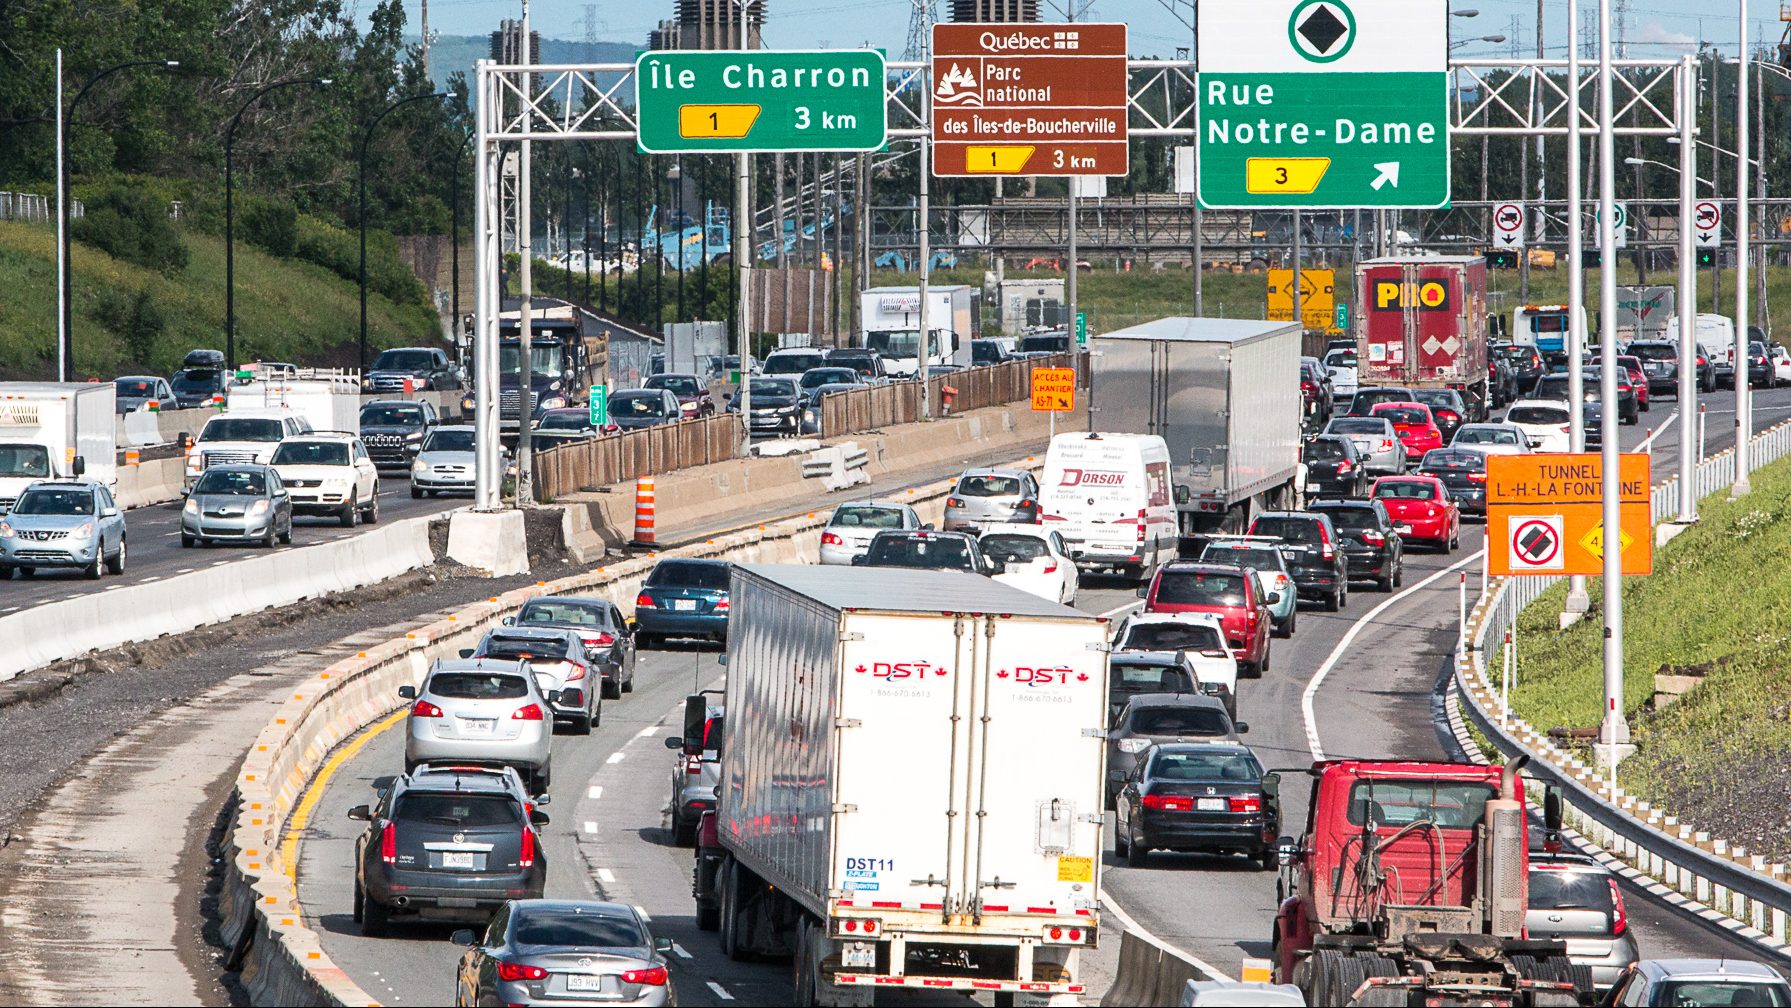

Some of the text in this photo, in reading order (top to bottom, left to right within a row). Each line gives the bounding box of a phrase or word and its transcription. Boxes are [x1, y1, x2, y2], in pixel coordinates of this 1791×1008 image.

[979, 31, 1051, 52] Québec
[649, 59, 870, 89] Île Charron
[986, 64, 1021, 81] Parc
[986, 85, 1051, 102] national
[1207, 80, 1274, 106] Rue
[708, 112, 719, 131] 1
[794, 106, 857, 130] 3 km
[943, 114, 1116, 134] des Îles-de-Boucherville
[1207, 118, 1436, 144] Notre-Dame
[991, 151, 997, 167] 1
[1053, 150, 1097, 168] 3 km
[1274, 166, 1289, 185] 3
[1377, 282, 1446, 308] PRO
[1034, 385, 1072, 393] CHANTIER
[592, 399, 600, 410] 3
[1057, 468, 1126, 488] DORSON
[1539, 465, 1600, 479] TUNNEL
[1564, 481, 1643, 496] FONTINE
[873, 662, 931, 680] DST
[1015, 667, 1073, 684] DST
[846, 857, 893, 871] DST11
